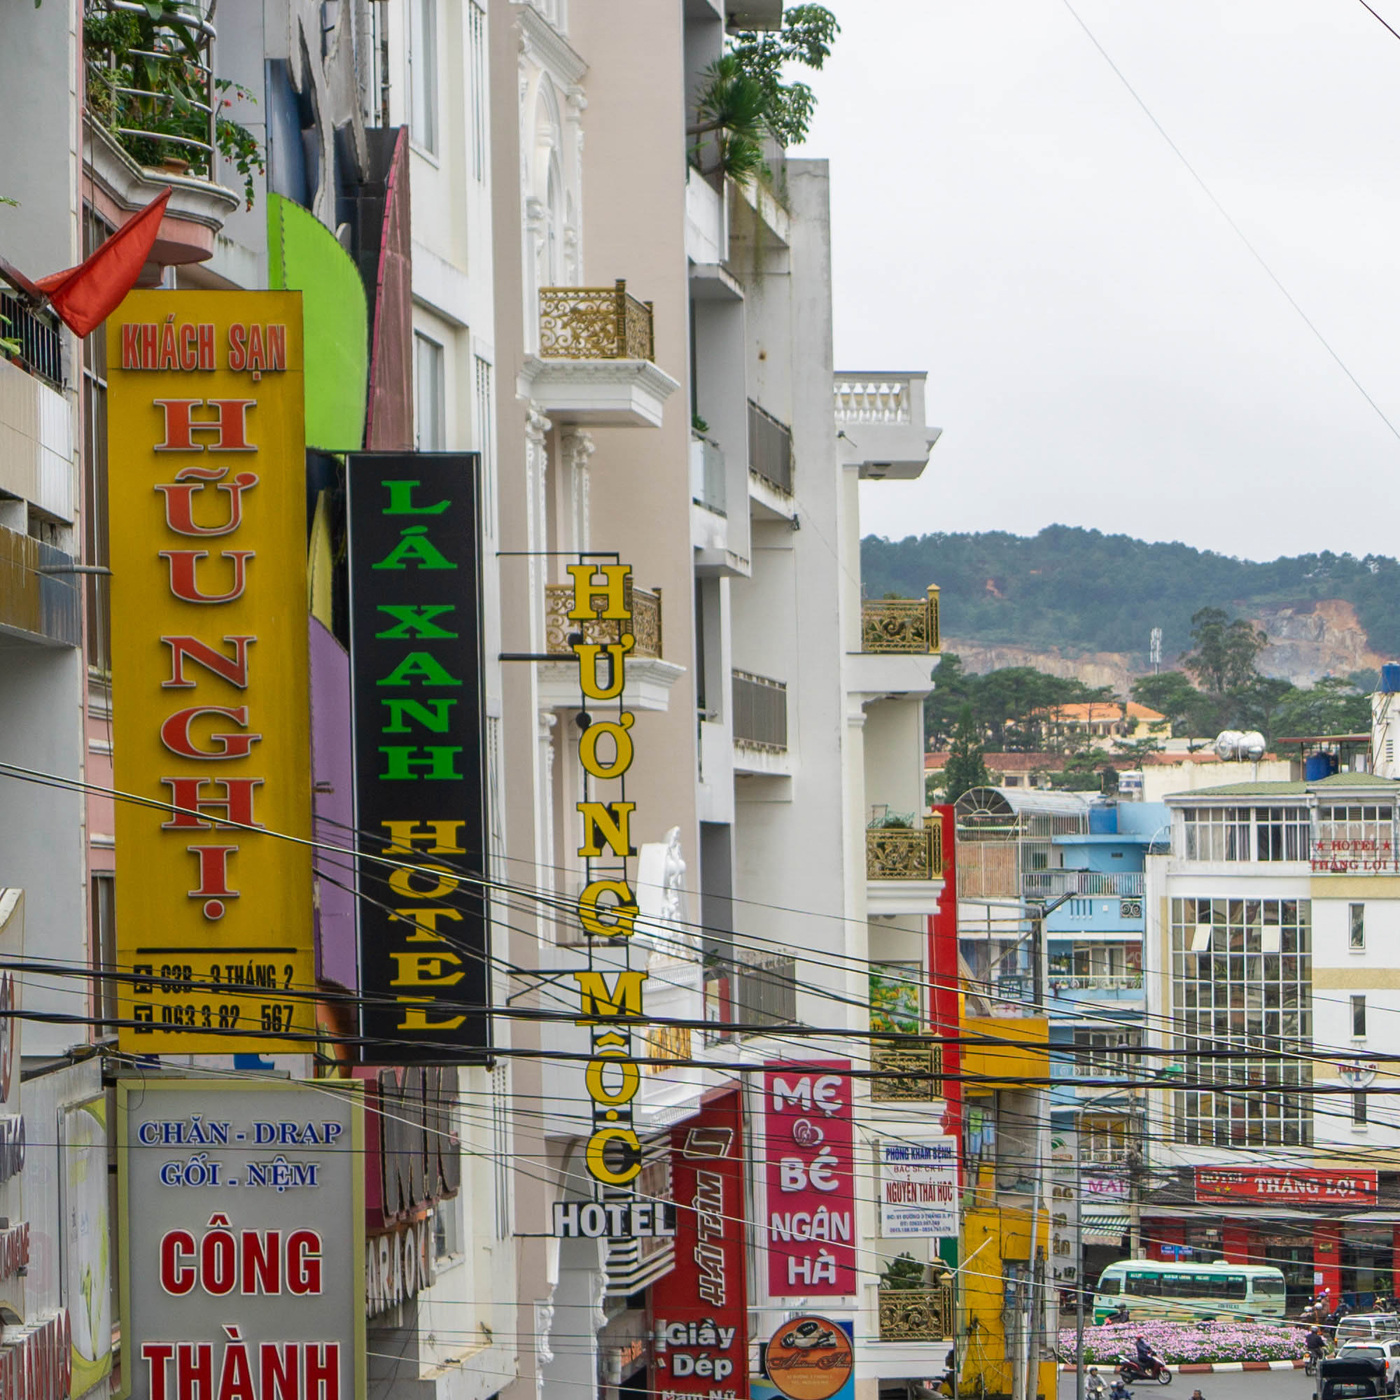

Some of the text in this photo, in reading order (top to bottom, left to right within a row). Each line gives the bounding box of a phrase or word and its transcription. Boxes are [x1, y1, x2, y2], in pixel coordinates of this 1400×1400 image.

[121, 314, 287, 380] KHÁCH SẠN
[153, 399, 259, 605] HỮU
[371, 480, 458, 569] LÁ
[375, 605, 463, 780] XANH
[566, 563, 640, 936] HƯƠNG
[160, 635, 264, 921] NGHỊ
[1331, 840, 1380, 851] HOTEL
[380, 820, 467, 1030] HOTEL
[261, 1004, 294, 1032] 567
[574, 971, 650, 1184] MỘC
[772, 1074, 843, 1119] MẸ
[137, 1121, 343, 1146] CHĂN DRAP
[159, 1154, 318, 1193] GỐI NỆM
[779, 1156, 840, 1193] BÉ
[553, 1202, 677, 1237] HOTEL
[770, 1205, 851, 1243] NGÂN
[159, 1212, 324, 1297] CÔNG
[786, 1260, 836, 1286] HÀ
[666, 1319, 736, 1350] Giầy
[673, 1353, 734, 1381] Dép
